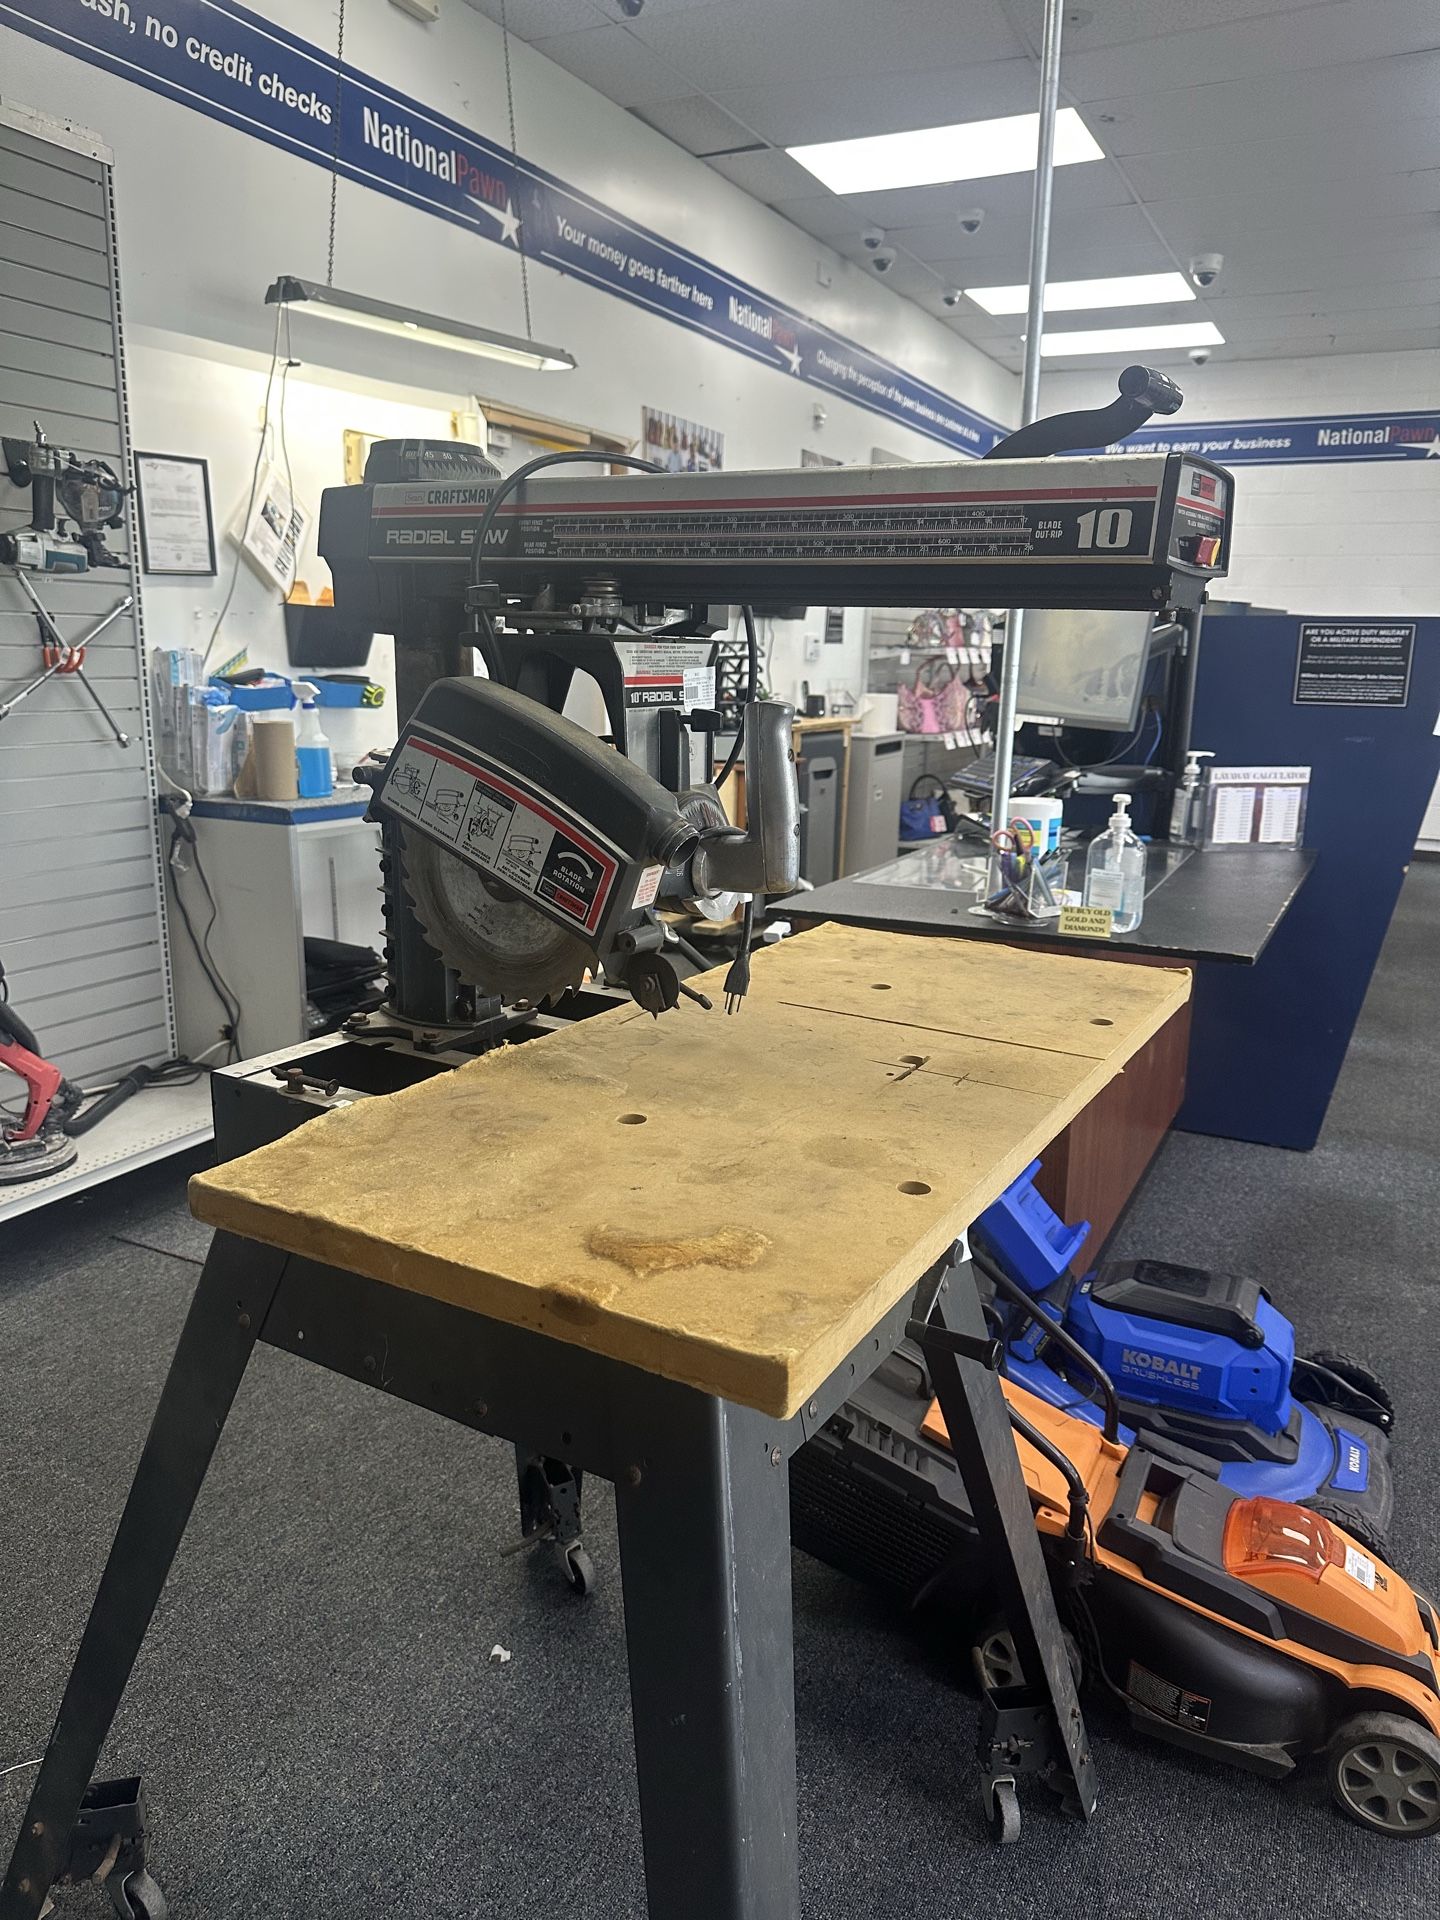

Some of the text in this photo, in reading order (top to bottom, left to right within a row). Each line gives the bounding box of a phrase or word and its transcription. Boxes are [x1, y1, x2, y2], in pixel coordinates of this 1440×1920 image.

[145, 15, 179, 48] no
[185, 37, 254, 86] credit
[258, 73, 332, 125] checks
[556, 215, 714, 310] Your money goes farther here
[1104, 437, 1292, 454] We want to earn your business
[427, 488, 495, 504] CRAFTSMAN
[1038, 520, 1062, 529] BLADE
[1077, 508, 1133, 549] 10
[460, 529, 509, 544] SW
[1035, 530, 1063, 539] OUT-RIP
[1214, 771, 1307, 780] LAYAWAY CALCULATOR
[552, 869, 586, 894] ROTATION
[560, 865, 582, 883] BLADE
[1065, 915, 1087, 923] GOLD
[1076, 907, 1091, 915] BUY
[1093, 908, 1111, 916] OLD
[1064, 924, 1105, 933] DIAMONDS
[1122, 1348, 1202, 1380] KOBALT
[1120, 1364, 1200, 1391] BRUSHLESS
